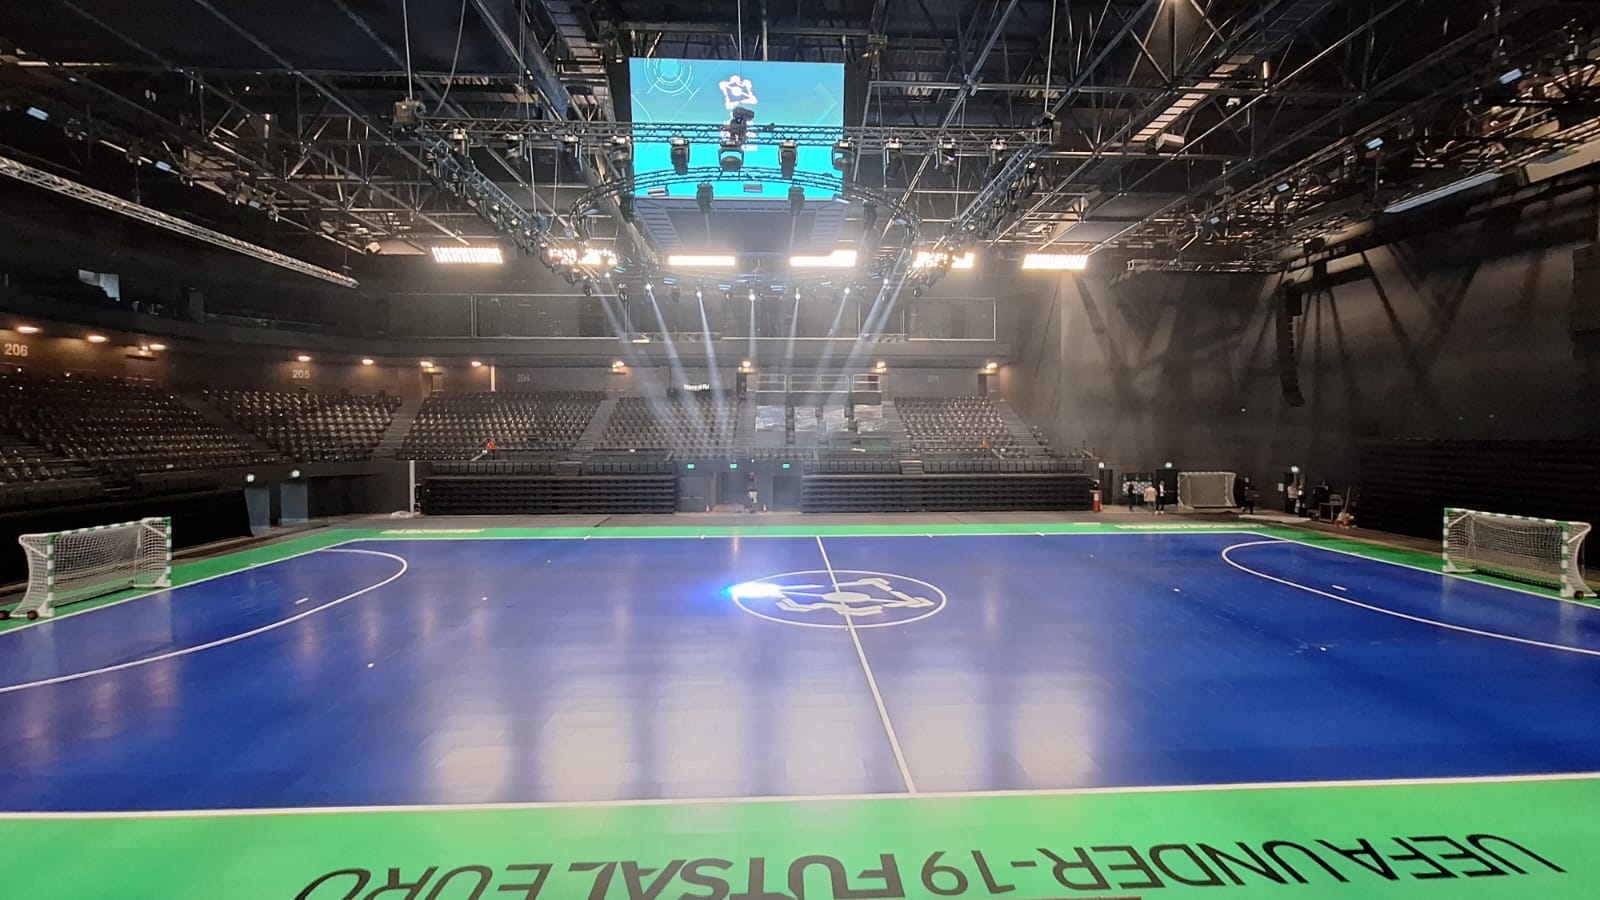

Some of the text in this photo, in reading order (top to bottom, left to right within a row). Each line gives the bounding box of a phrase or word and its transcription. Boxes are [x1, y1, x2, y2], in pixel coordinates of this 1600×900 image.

[4, 343, 29, 357] 206
[292, 369, 311, 380] 205
[293, 833, 1567, 900] UEFA UNDER-19 FUTSAL EURO
